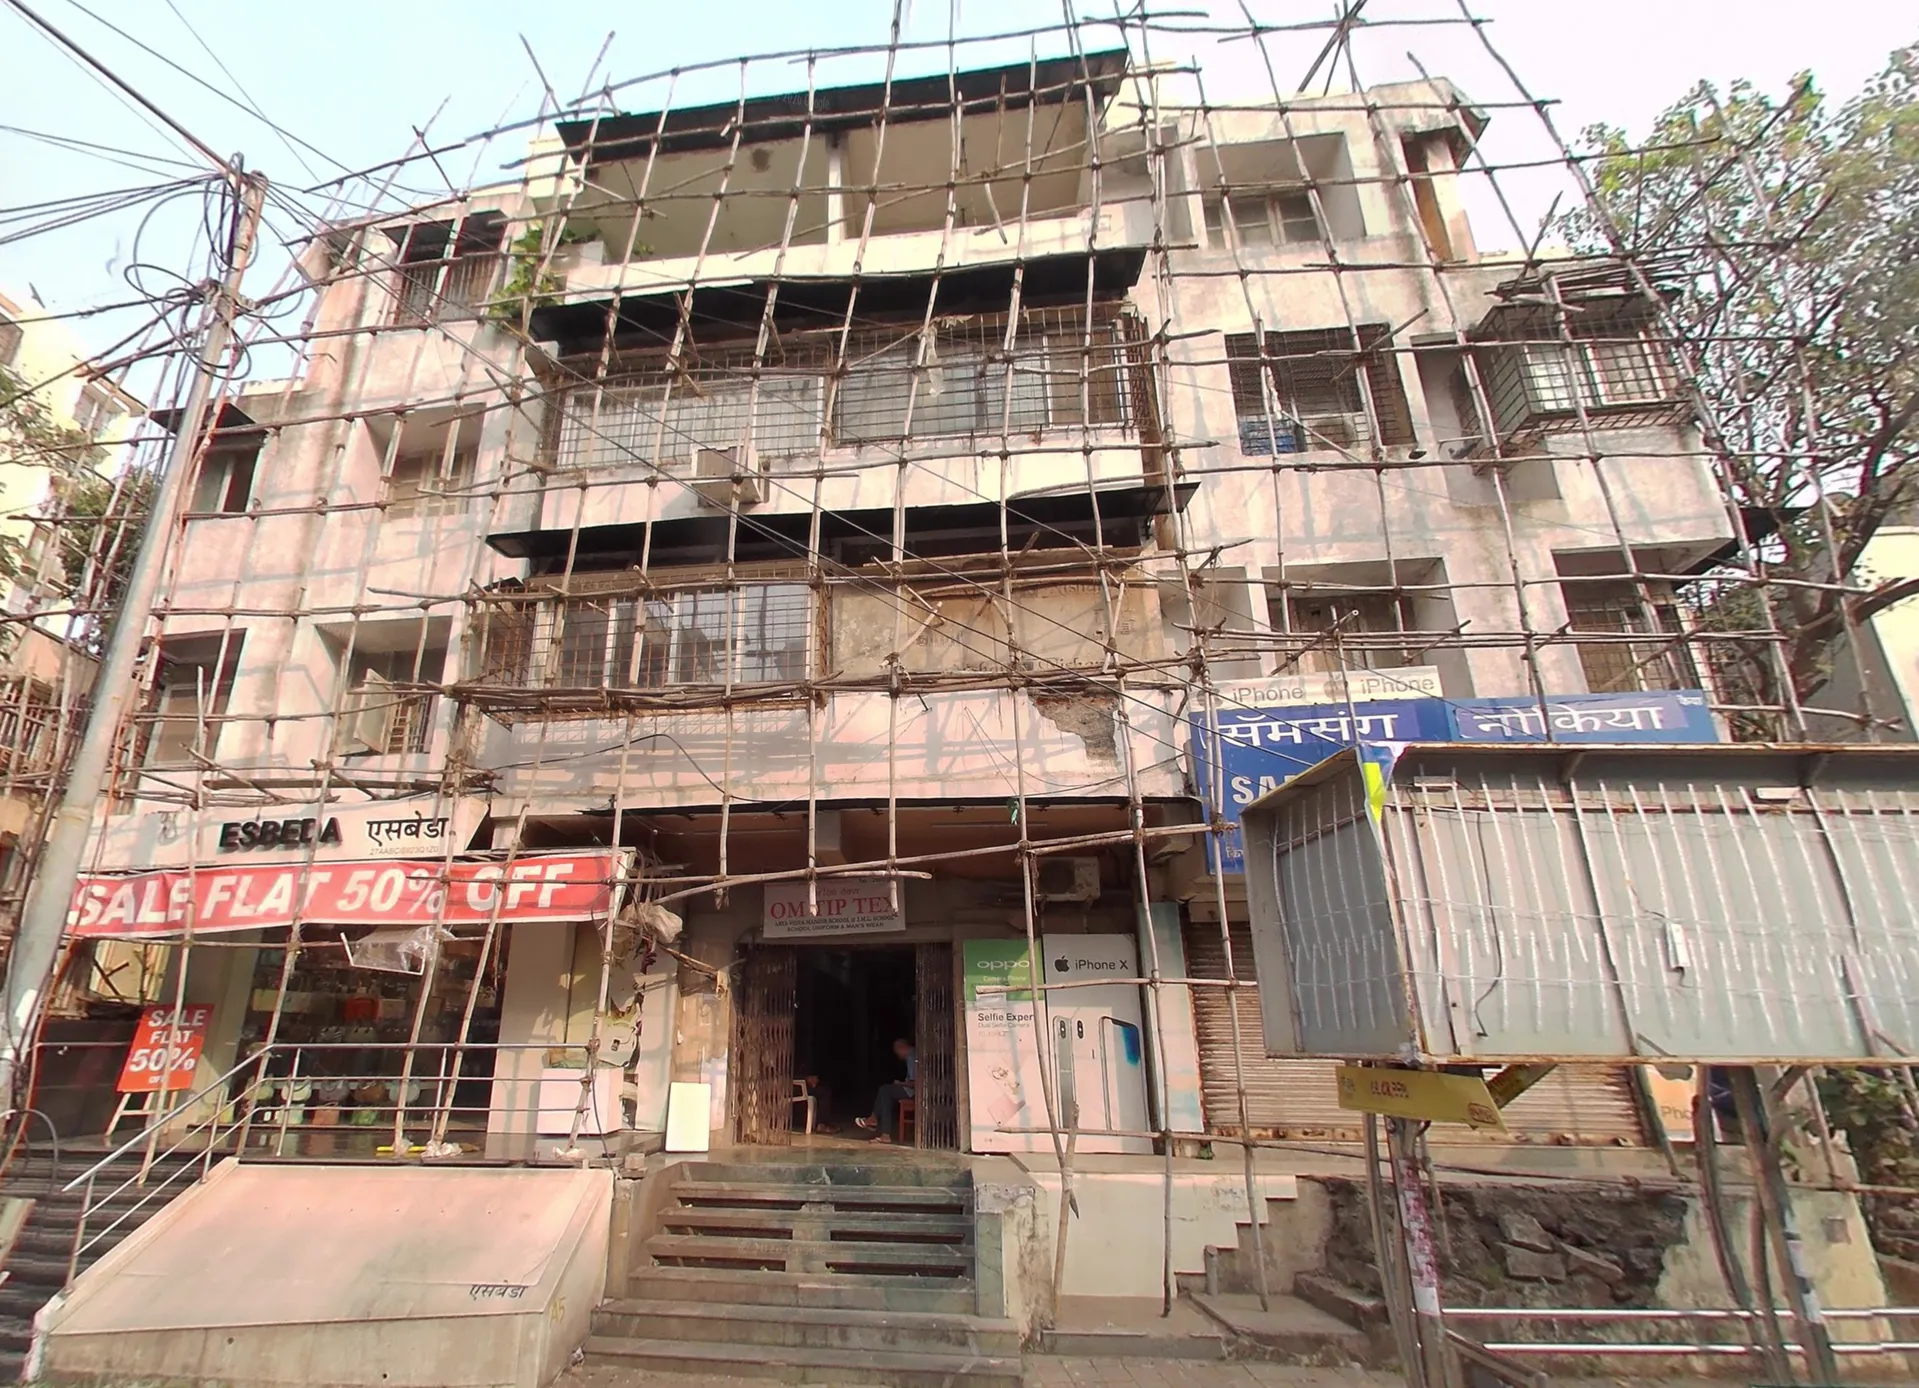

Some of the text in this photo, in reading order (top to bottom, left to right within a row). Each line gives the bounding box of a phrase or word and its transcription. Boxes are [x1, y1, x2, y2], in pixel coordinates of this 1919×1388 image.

[1233, 678, 1435, 702] iPhone iPhone
[1231, 775, 1297, 804] SA
[366, 810, 450, 847] एसबेडा
[68, 863, 574, 927] SALE FLAT 50% OFF
[770, 901, 805, 919] OM
[977, 960, 1030, 971] oppo
[1075, 959, 1129, 971] iPhone X
[148, 1009, 207, 1028] SALE
[978, 1012, 1034, 1022] Selfie Exper
[149, 1030, 194, 1045] FLAT
[129, 1046, 196, 1072] 50%
